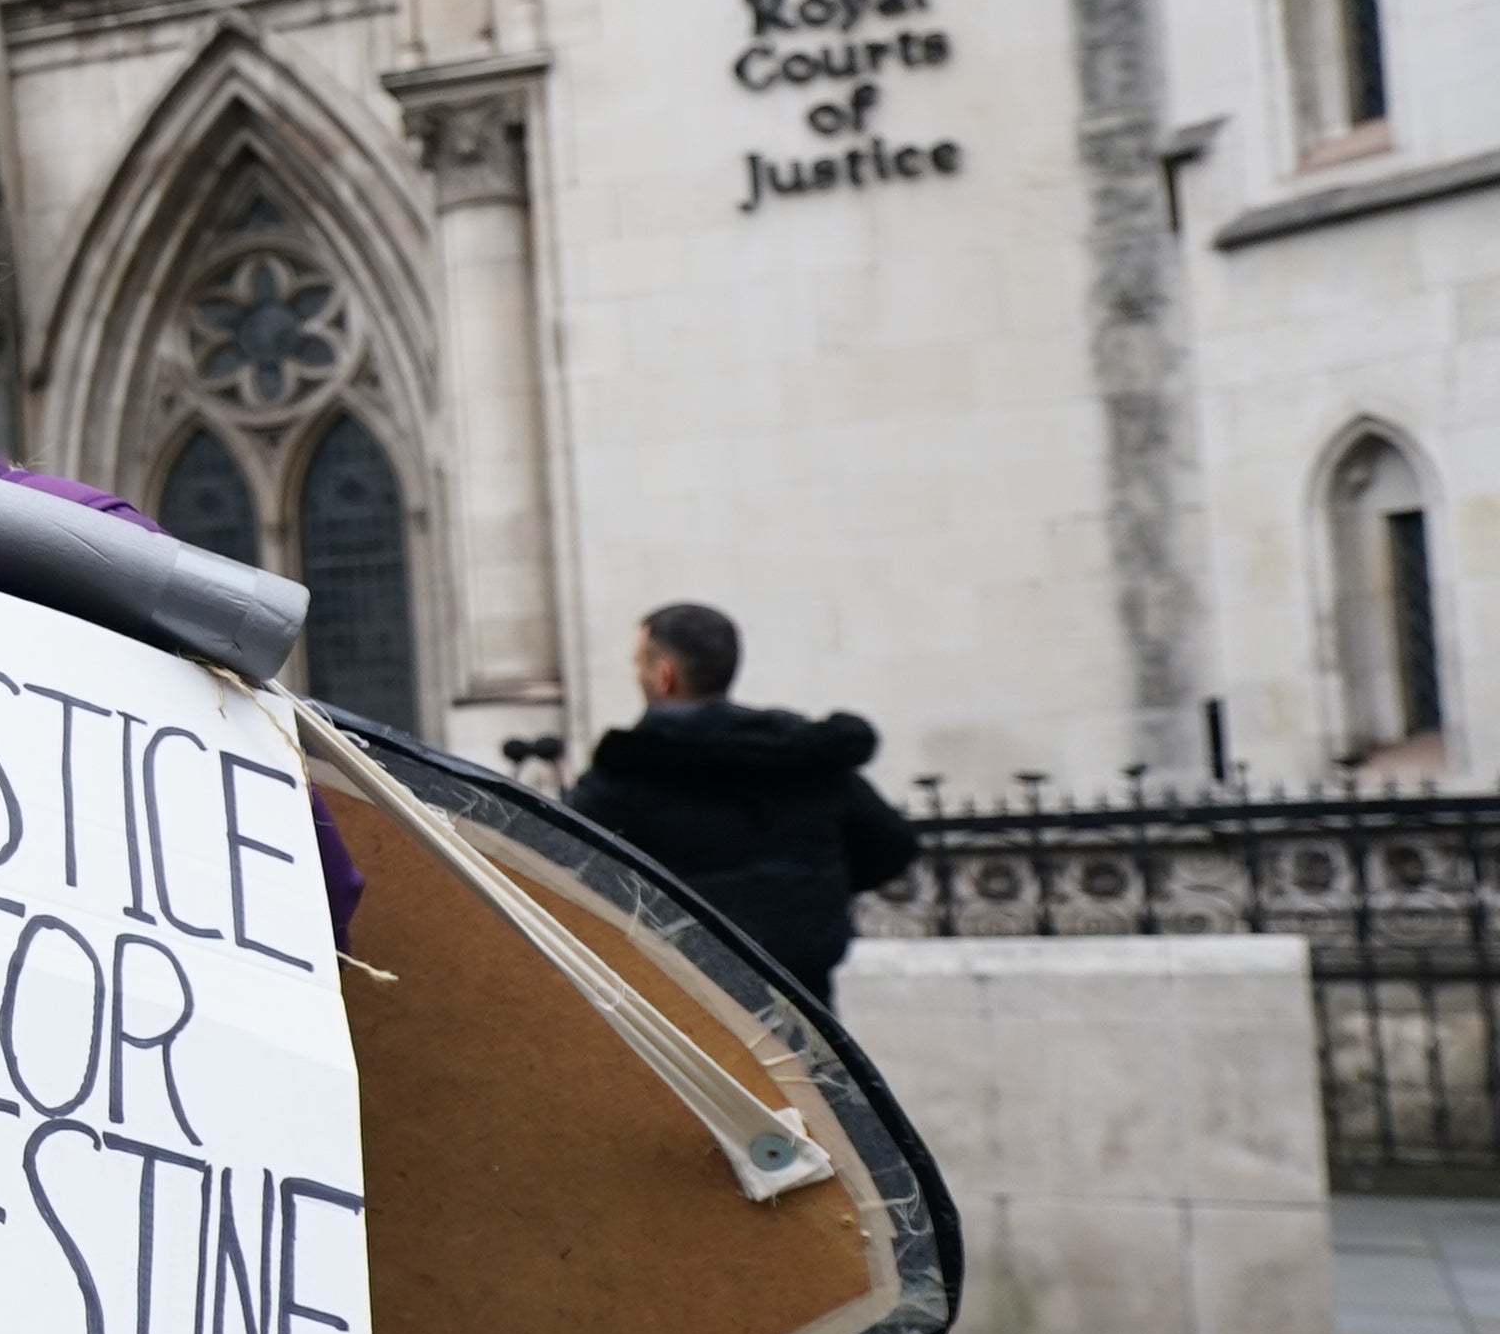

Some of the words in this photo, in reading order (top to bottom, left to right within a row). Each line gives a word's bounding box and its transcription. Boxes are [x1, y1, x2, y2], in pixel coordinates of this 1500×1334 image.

[735, 28, 950, 91] Courts
[808, 83, 879, 135] of
[738, 138, 963, 212] Justice
